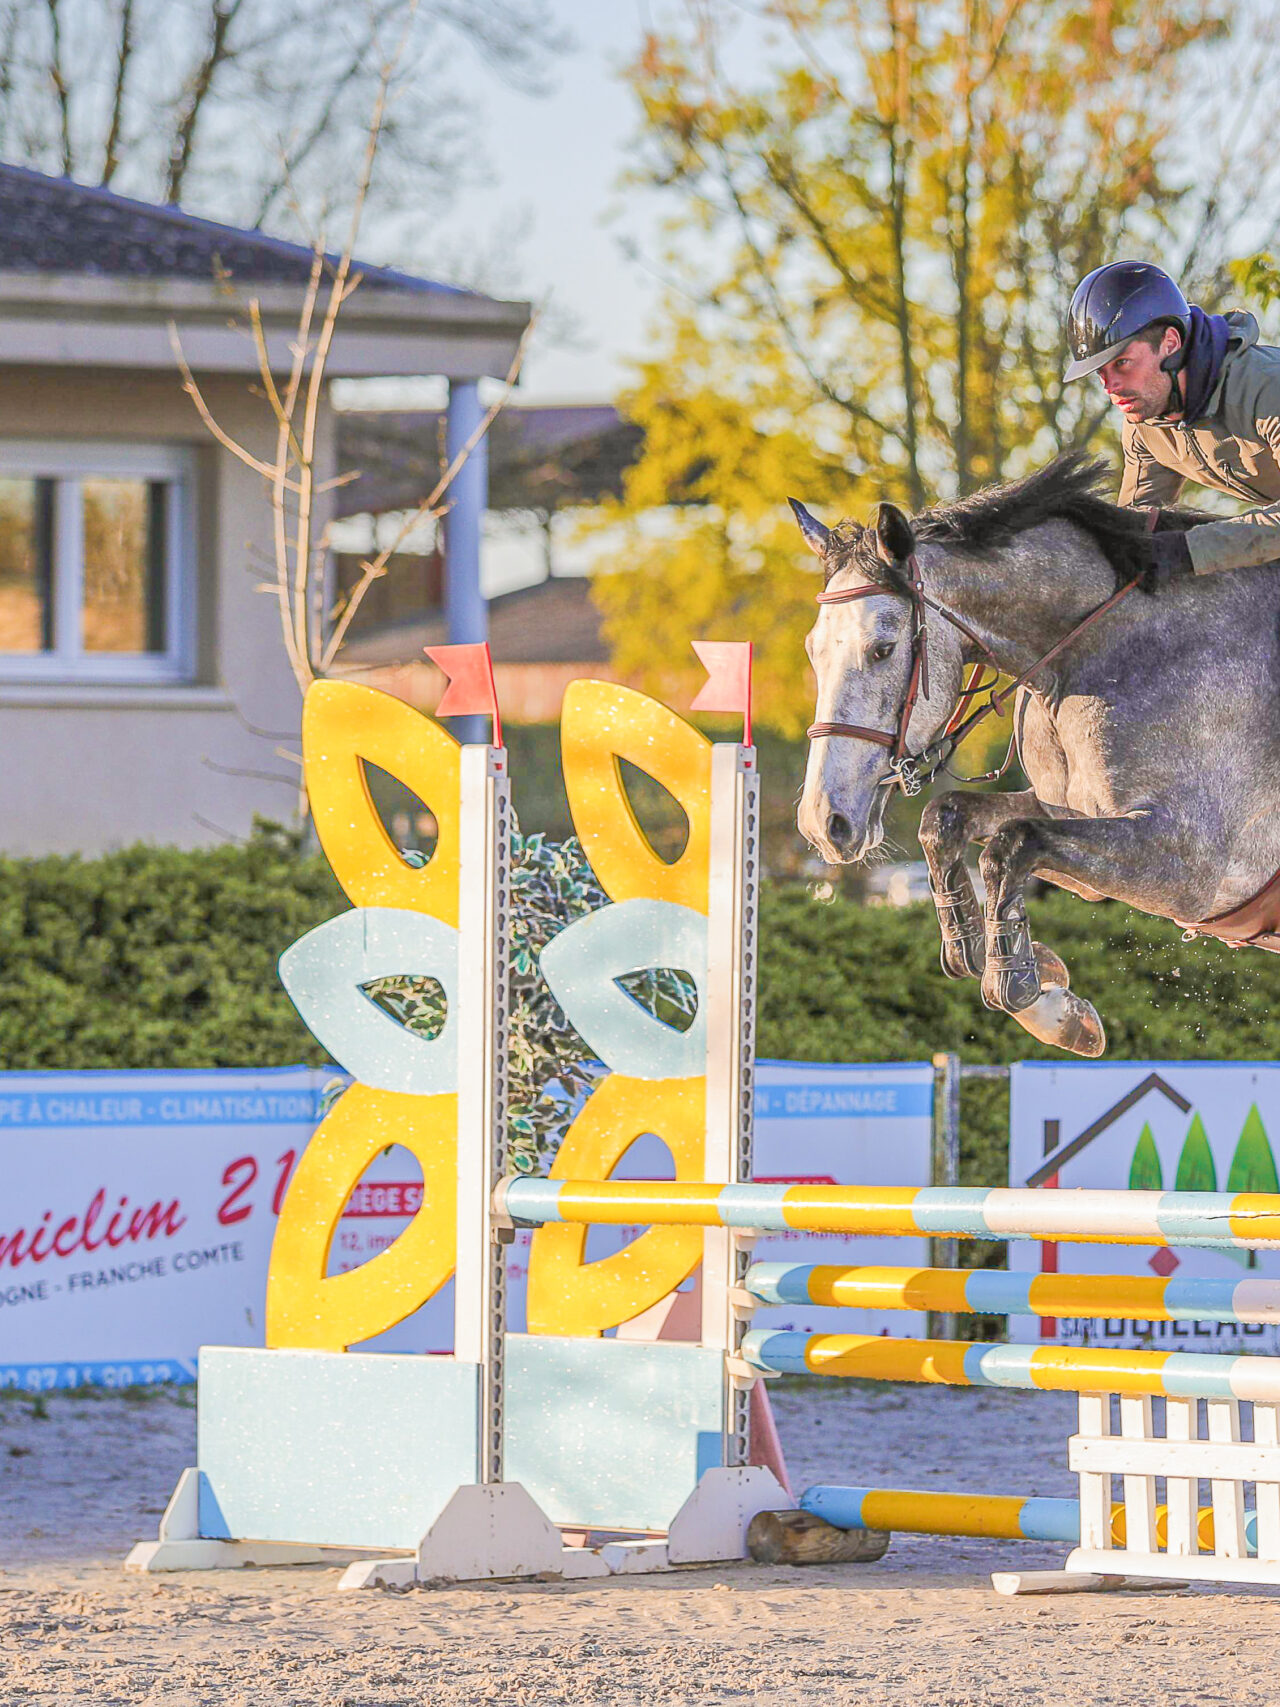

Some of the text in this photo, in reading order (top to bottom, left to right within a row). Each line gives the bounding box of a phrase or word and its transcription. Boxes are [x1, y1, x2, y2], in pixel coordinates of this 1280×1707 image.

[46, 1097, 142, 1121] CHALEUR
[160, 1095, 314, 1121] CLIMATISATION
[786, 1086, 897, 1112] DÉPANNAGE
[68, 1256, 168, 1292] FRANCHE
[172, 1241, 244, 1272] COMTE
